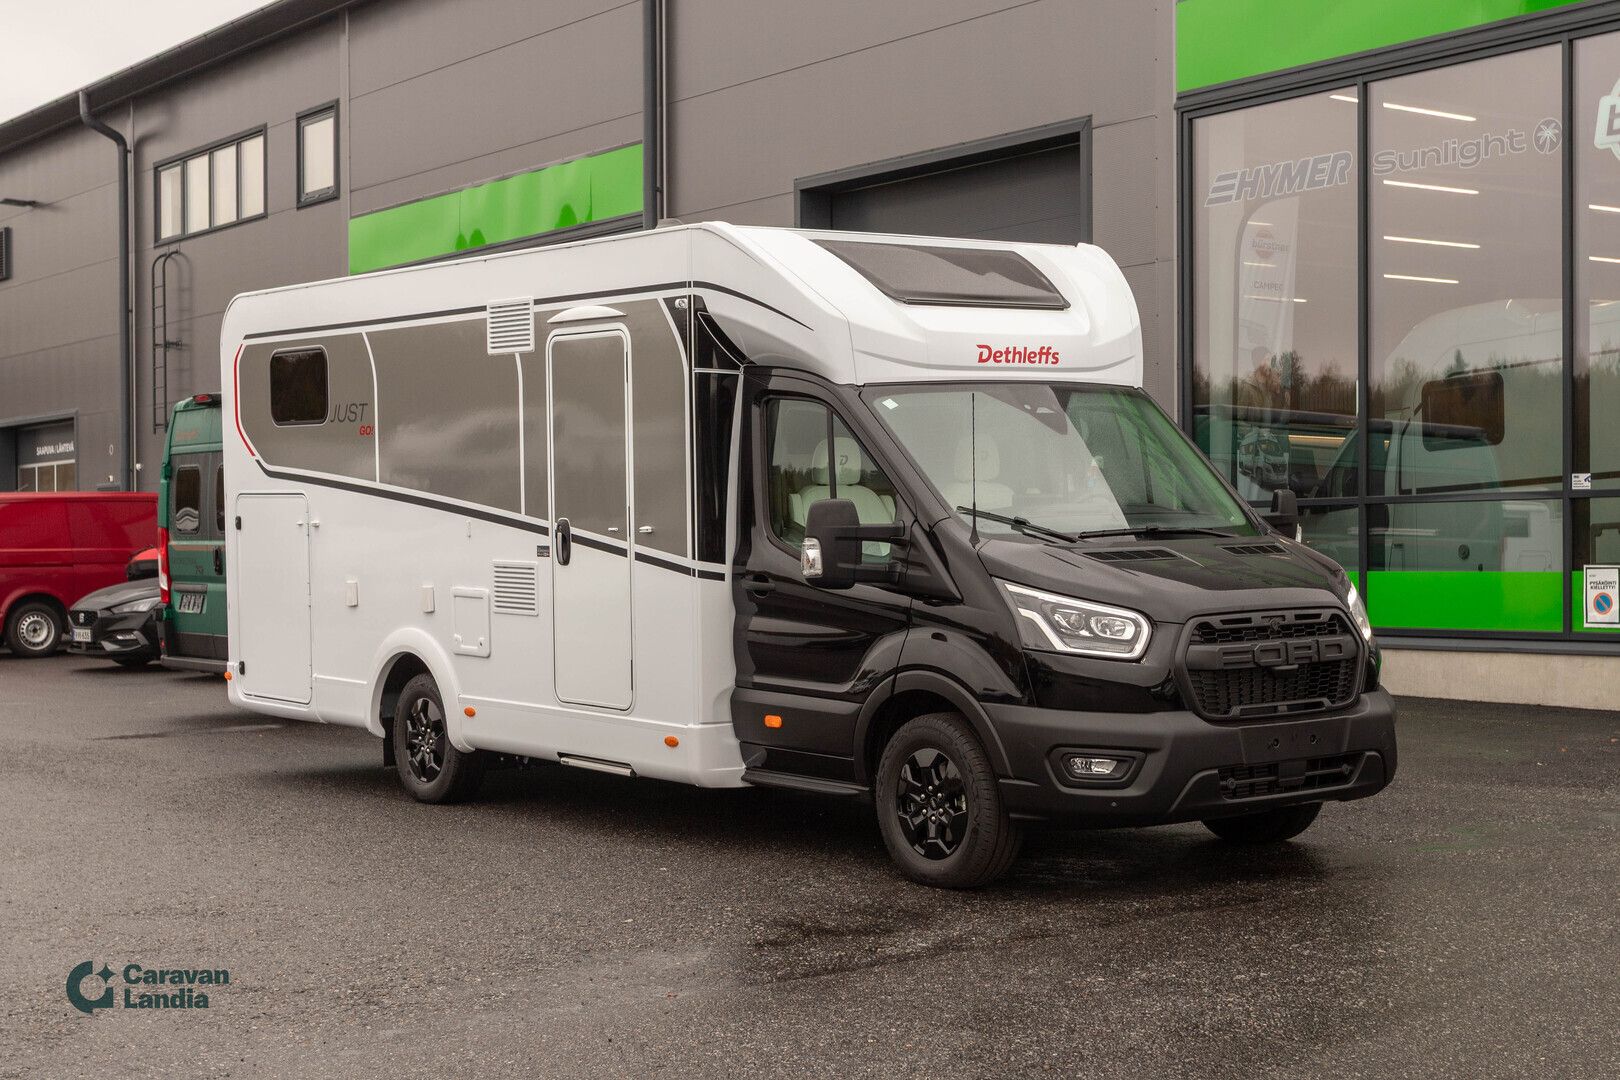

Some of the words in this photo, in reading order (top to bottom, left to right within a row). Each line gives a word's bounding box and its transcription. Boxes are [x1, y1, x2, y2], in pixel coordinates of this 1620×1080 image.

[1372, 128, 1526, 176] Sunlight
[1233, 151, 1353, 202] HYMER
[976, 344, 1060, 365] Dethleffs
[330, 403, 368, 423] JUST
[360, 425, 374, 436] GO!
[1217, 636, 1345, 671] FORD
